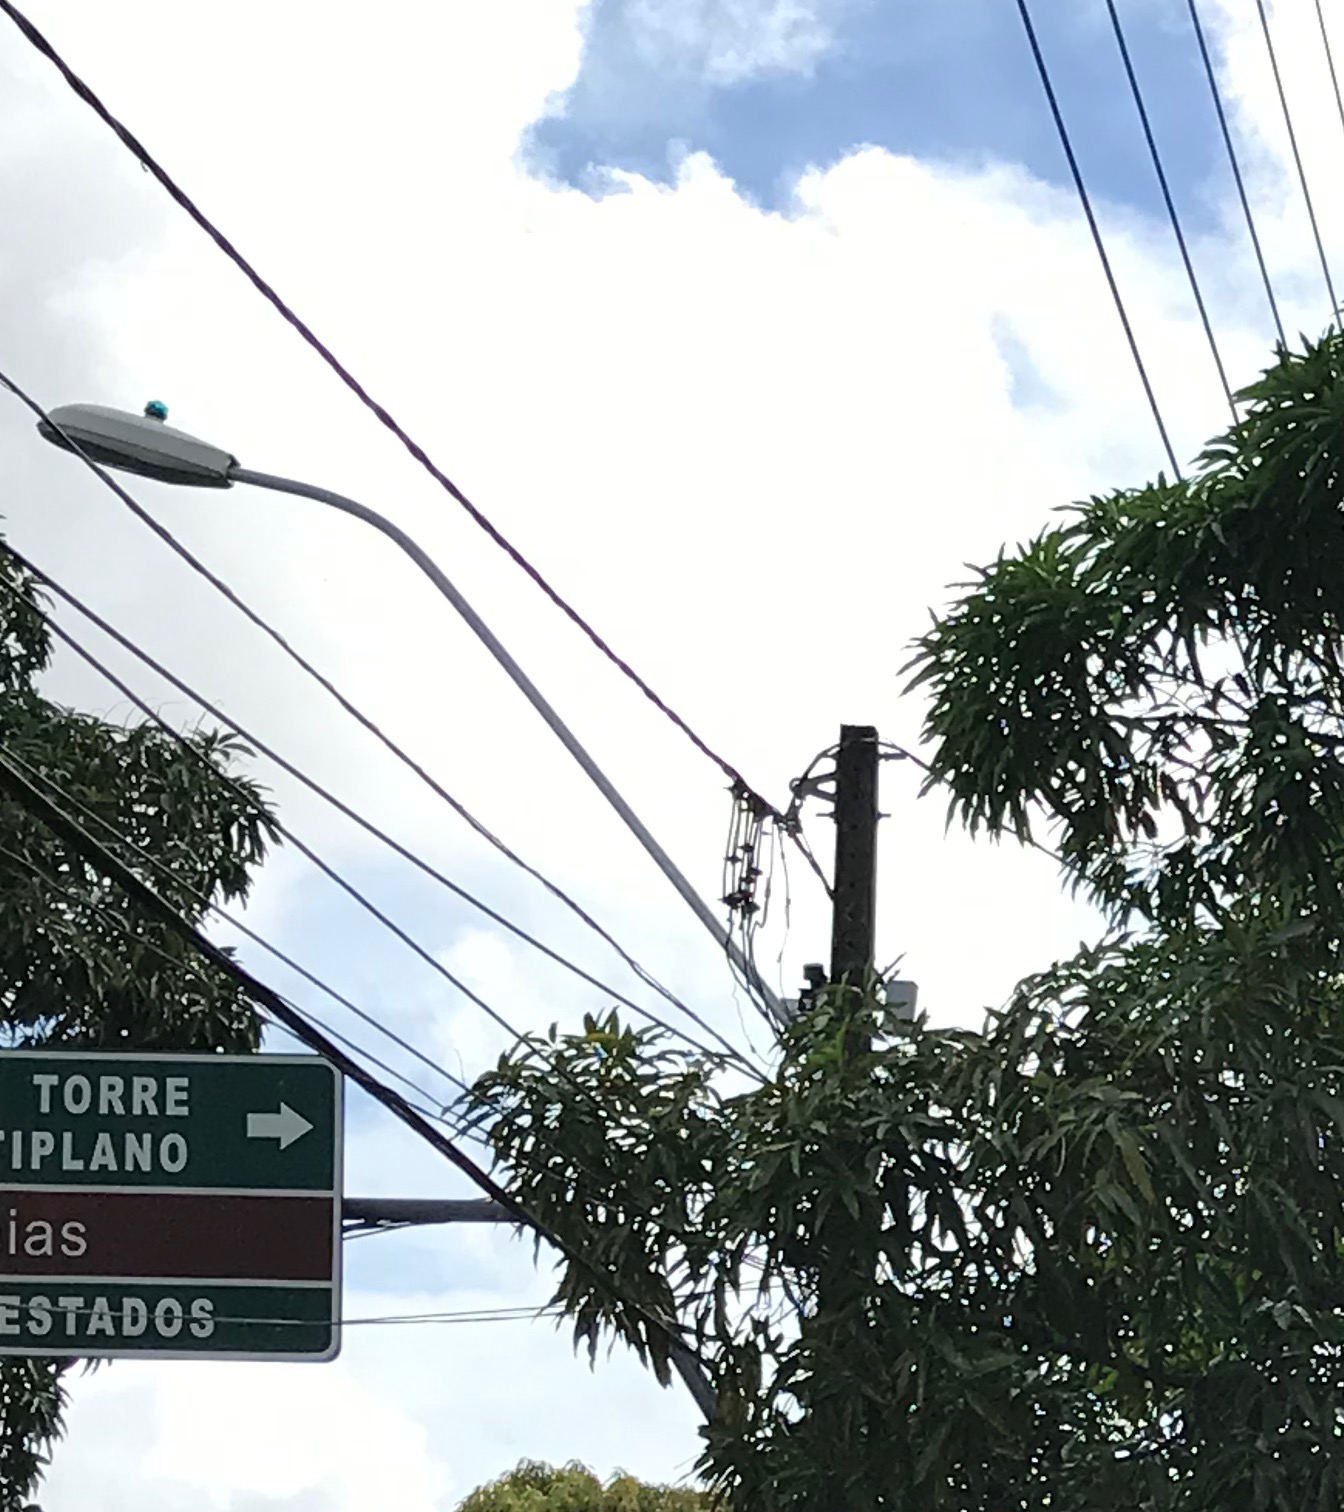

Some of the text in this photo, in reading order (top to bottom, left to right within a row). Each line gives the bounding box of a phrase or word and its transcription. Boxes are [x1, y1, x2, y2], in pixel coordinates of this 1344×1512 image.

[33, 1074, 190, 1116] TORRE
[0, 1130, 188, 1173] IPLANO
[0, 1295, 216, 1338] ESTADOS
